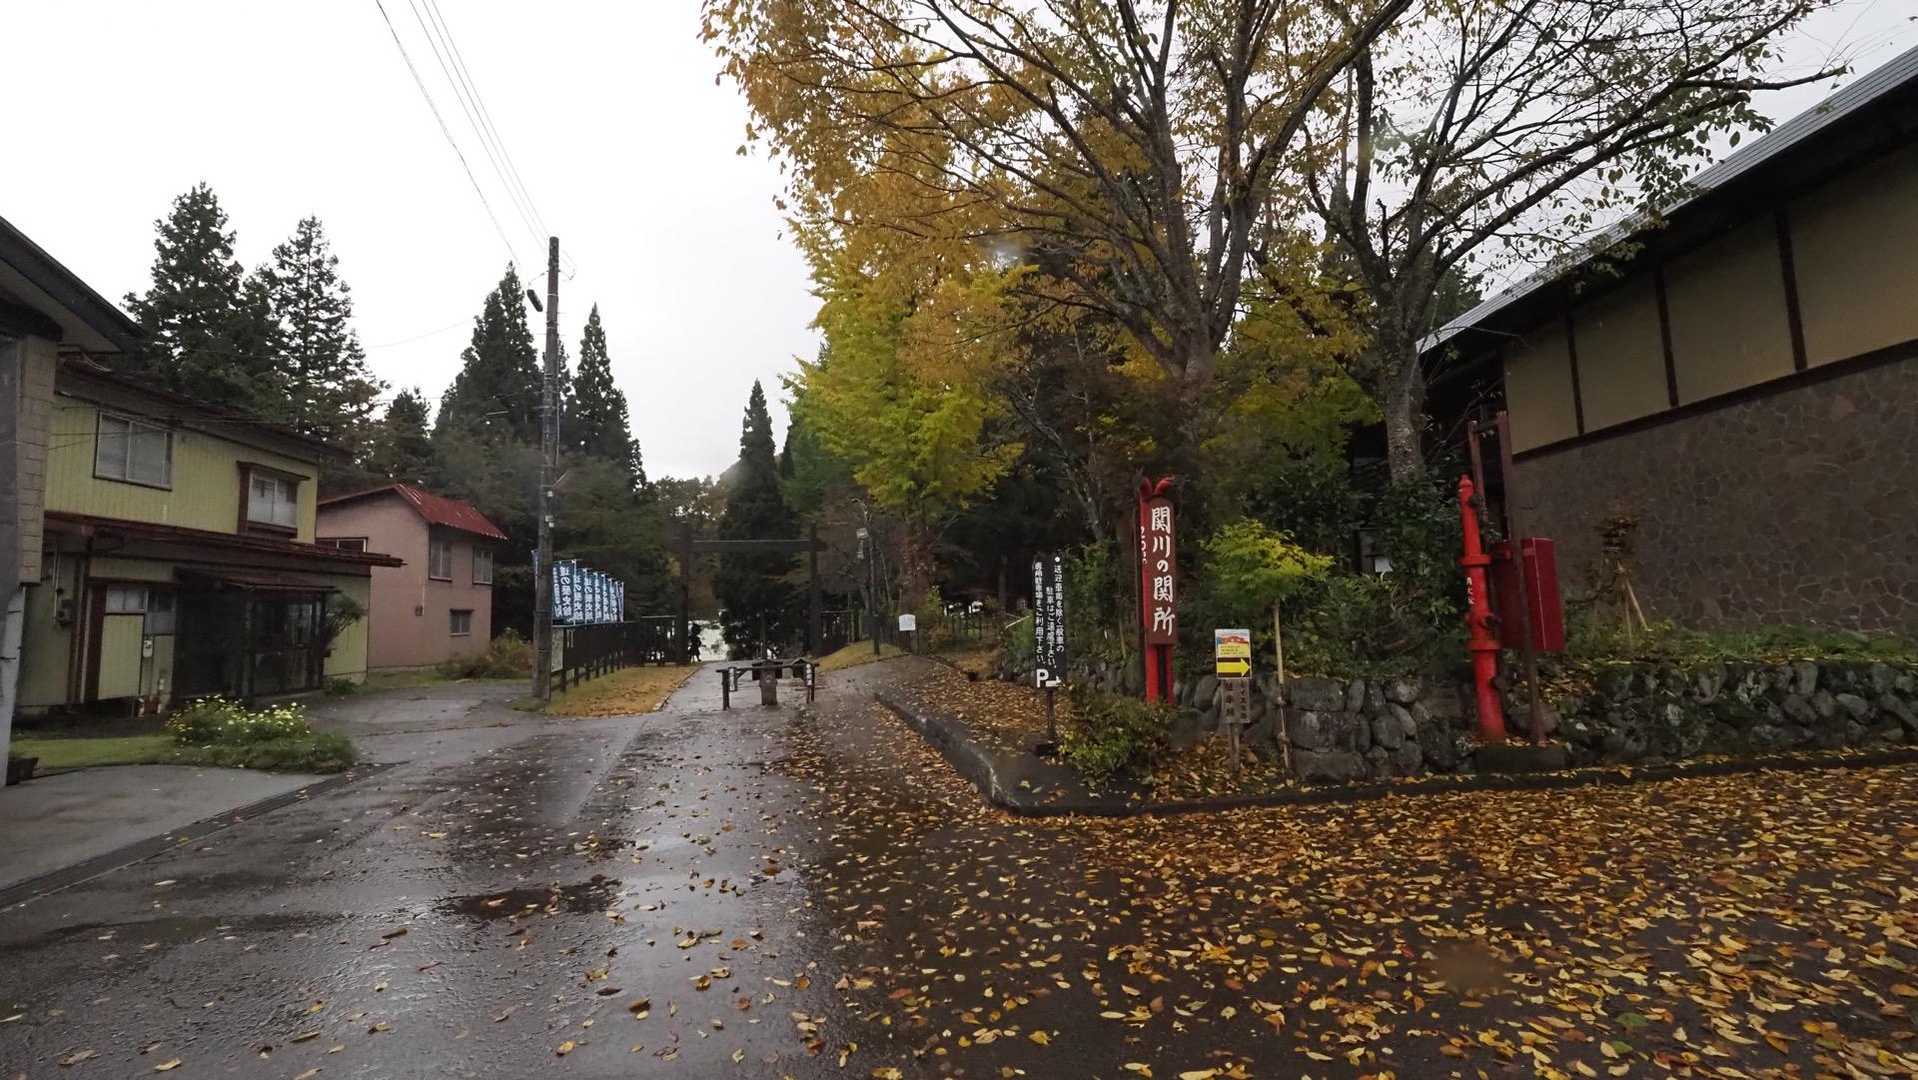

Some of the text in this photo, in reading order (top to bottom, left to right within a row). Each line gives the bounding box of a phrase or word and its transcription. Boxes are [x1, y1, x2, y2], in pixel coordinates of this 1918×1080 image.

[1151, 506, 1176, 636] 関川の関所
[1036, 668, 1049, 688] P
